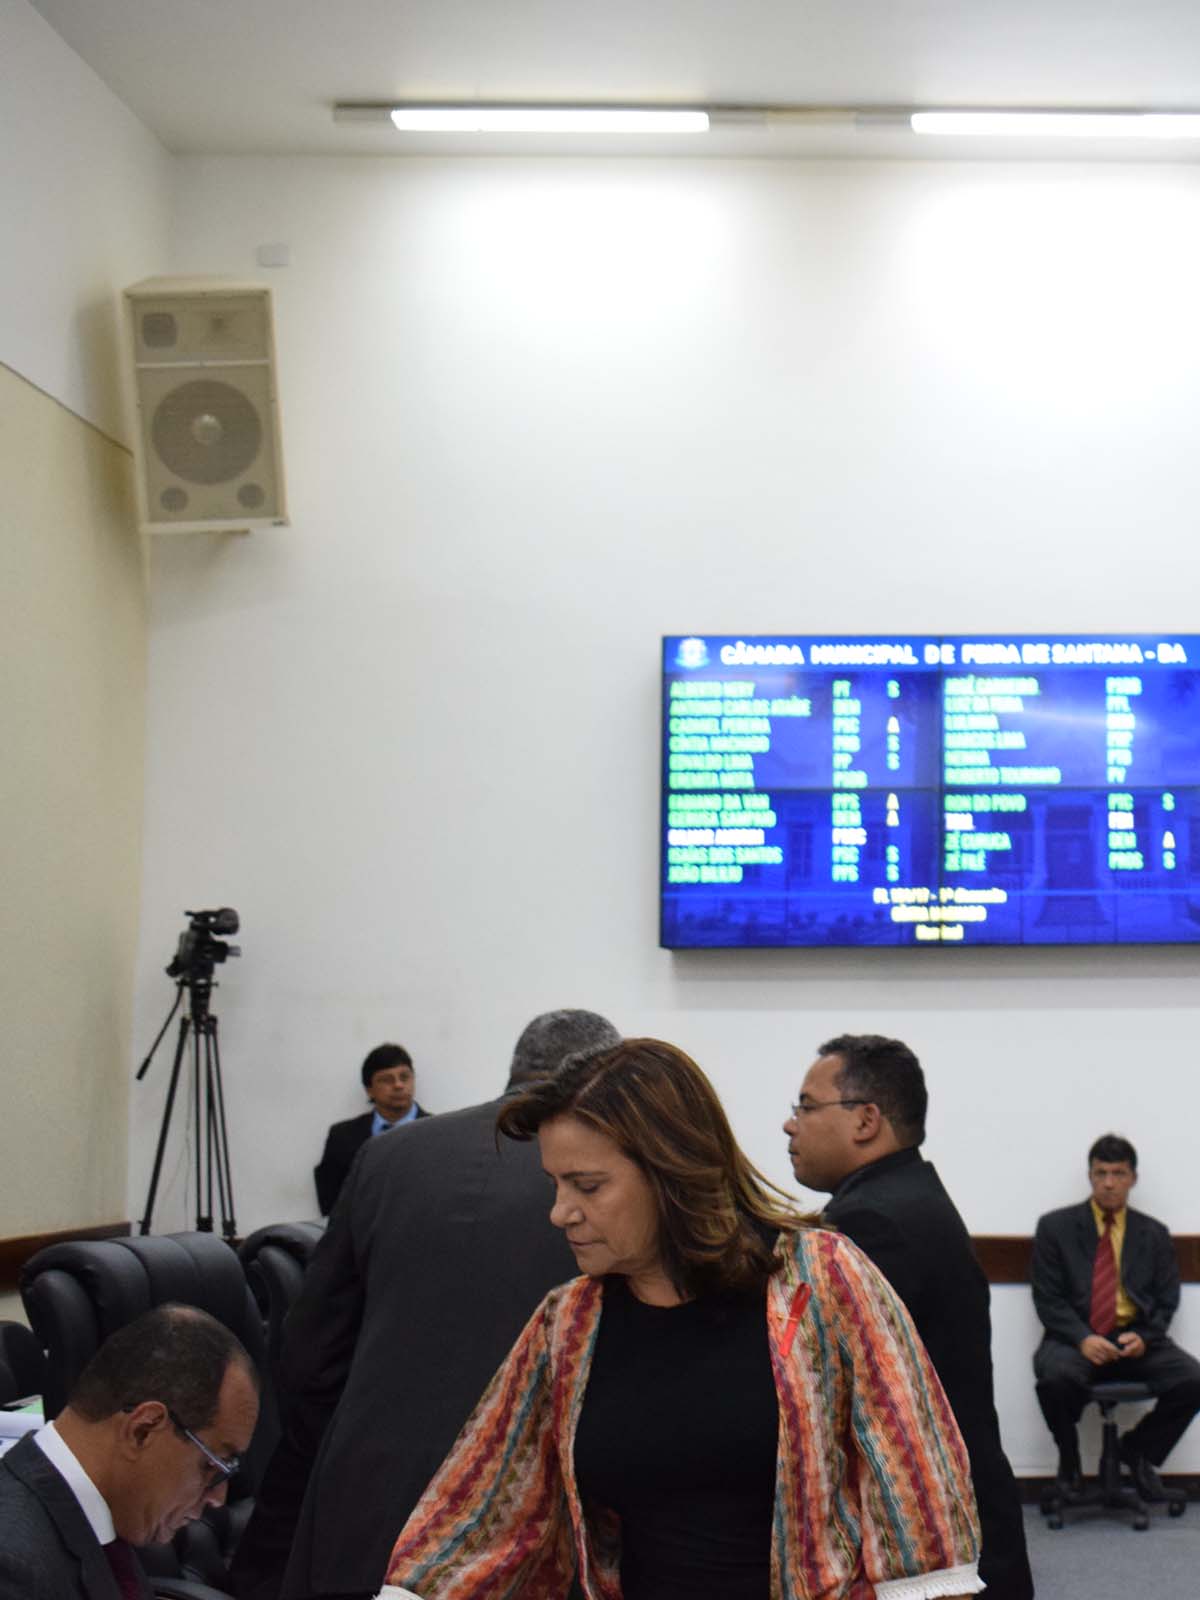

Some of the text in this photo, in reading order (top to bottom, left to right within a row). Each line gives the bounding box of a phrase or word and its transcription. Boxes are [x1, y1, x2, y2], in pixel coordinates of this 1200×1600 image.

[720, 641, 805, 665] CÂMARA
[810, 644, 919, 665] MUNICIPAL
[924, 643, 956, 664] DE
[1022, 643, 1050, 664] DE
[1051, 643, 1144, 664] SANTANA
[1157, 643, 1188, 664] BA
